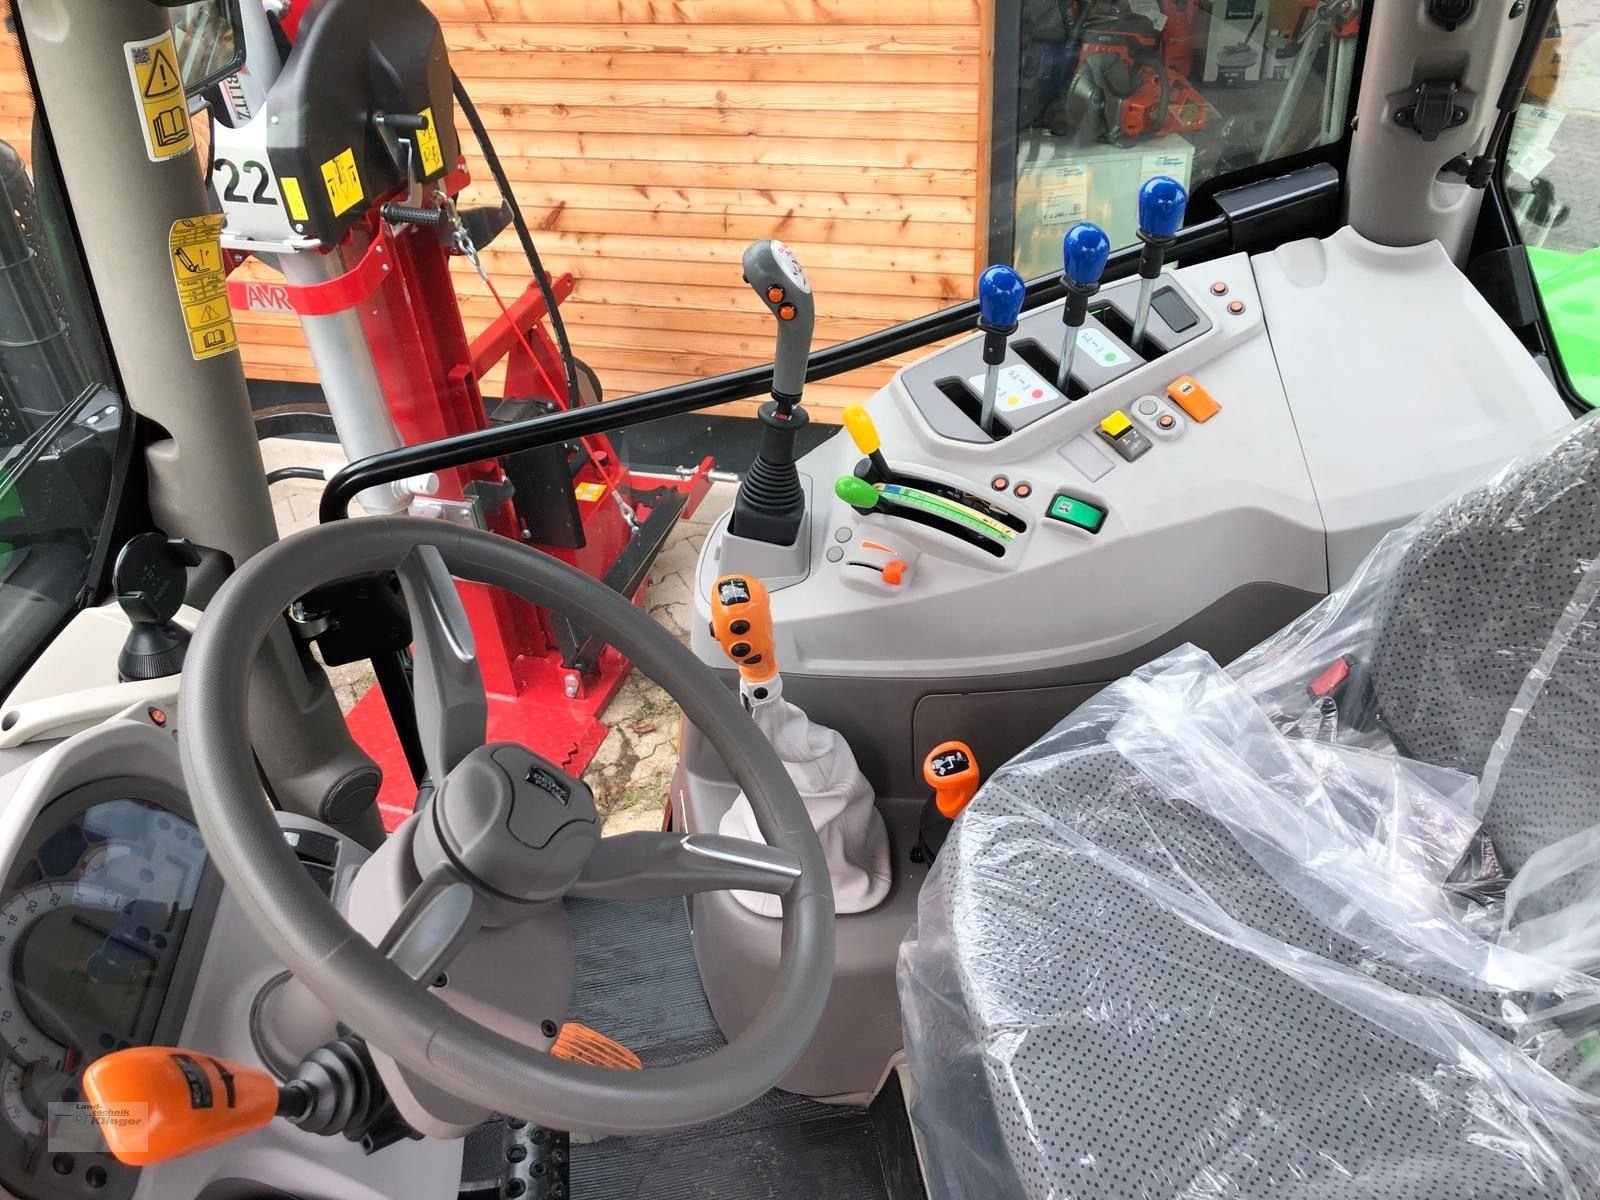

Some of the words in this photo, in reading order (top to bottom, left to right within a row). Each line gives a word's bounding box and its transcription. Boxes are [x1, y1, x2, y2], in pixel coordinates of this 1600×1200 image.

[214, 157, 279, 206] 22
[26, 900, 38, 914] 20
[7, 913, 18, 928] 18
[0, 1010, 13, 1024] 10
